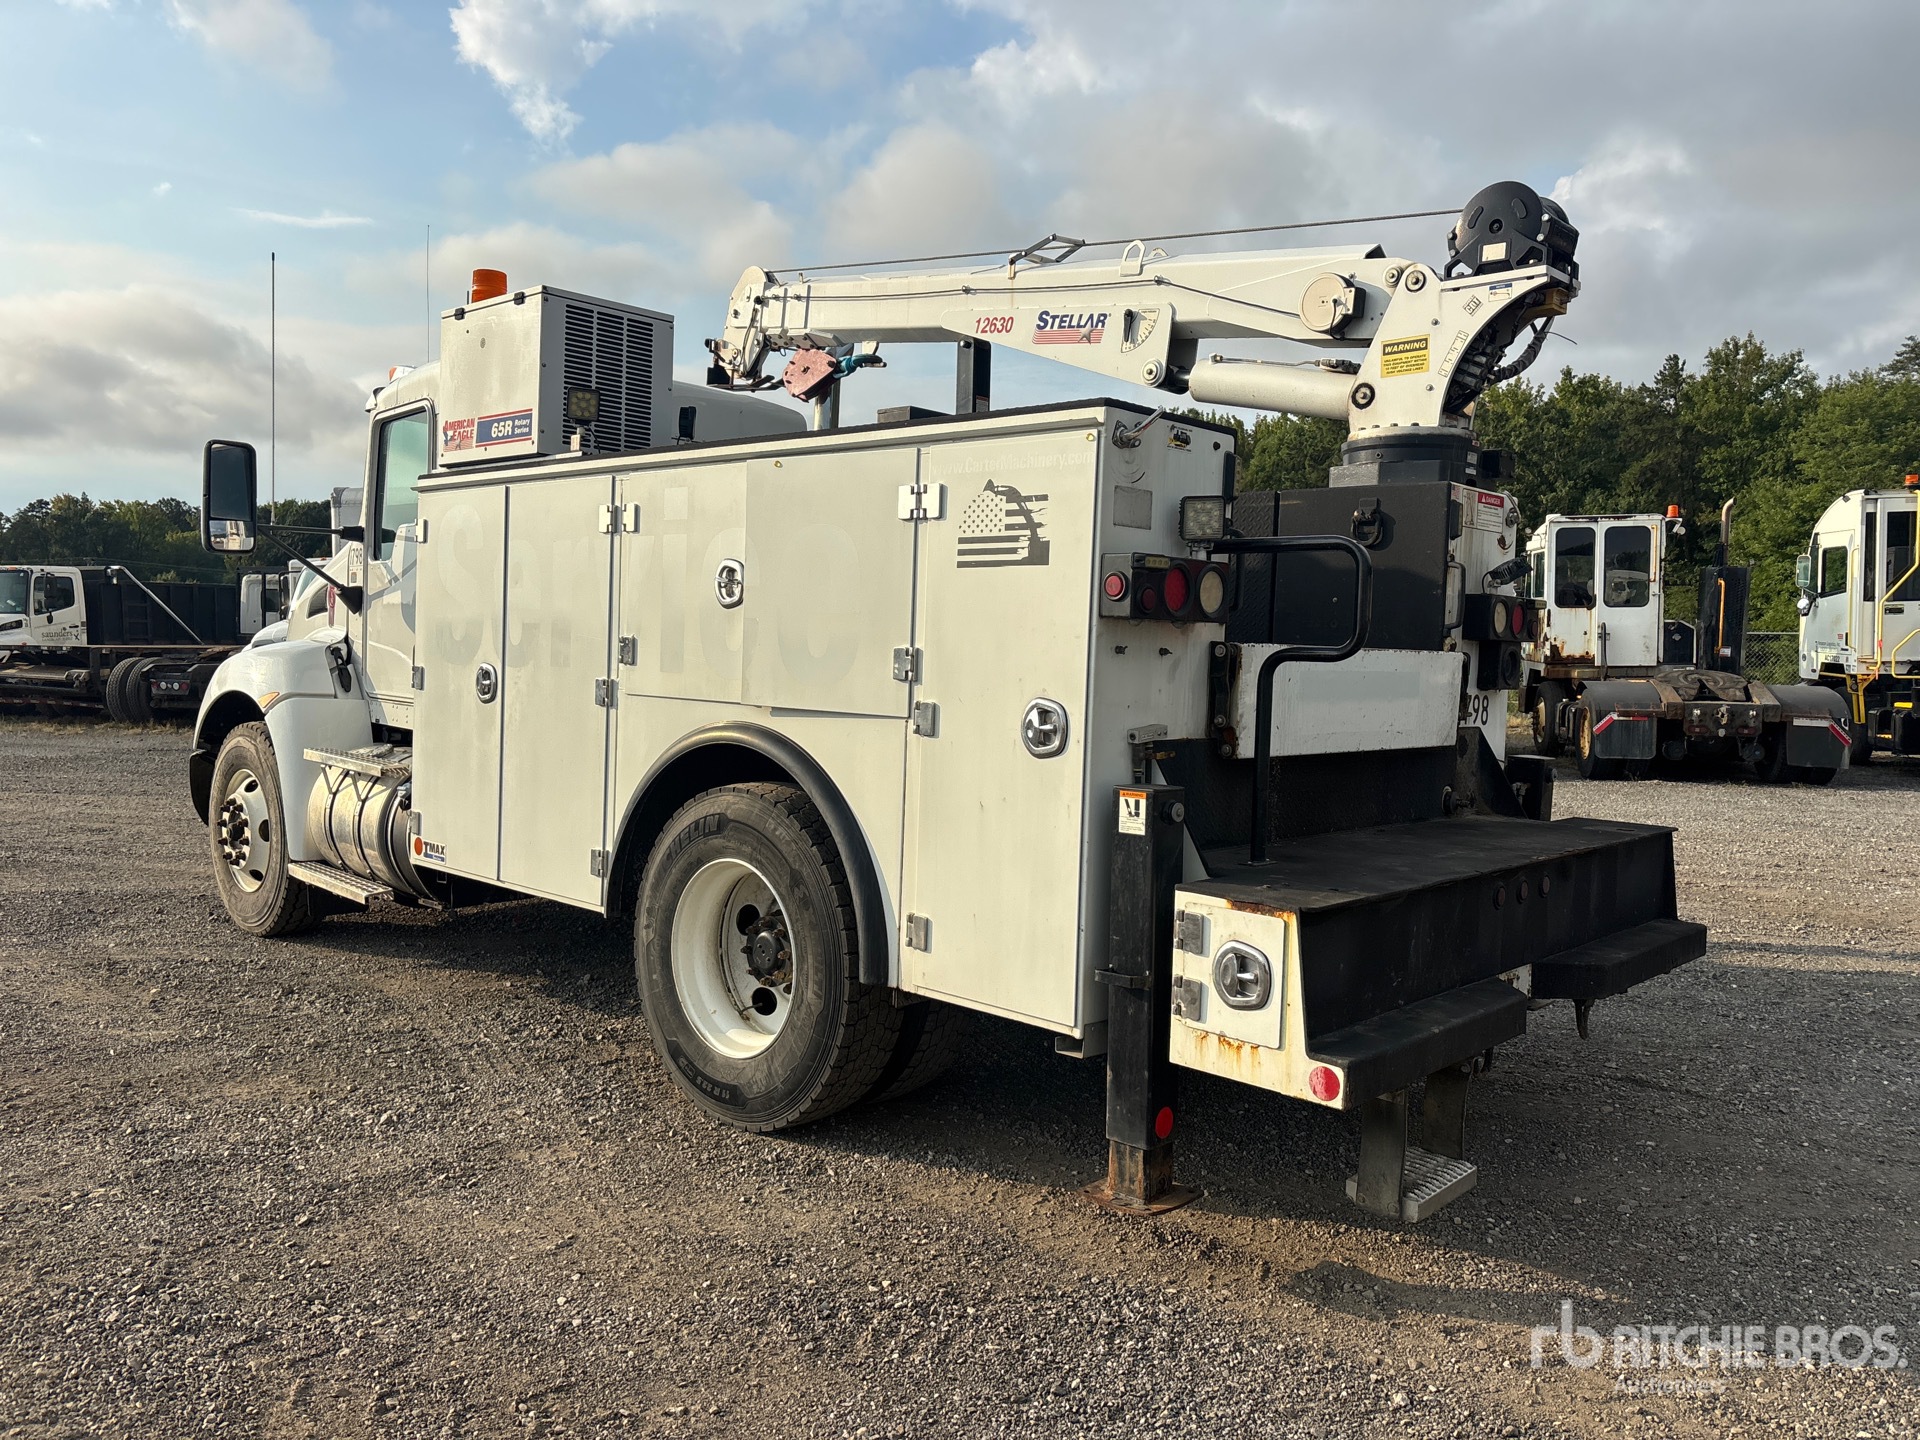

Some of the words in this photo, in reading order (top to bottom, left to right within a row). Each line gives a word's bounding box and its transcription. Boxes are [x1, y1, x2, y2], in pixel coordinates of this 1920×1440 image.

[975, 316, 1014, 334] 12630
[1035, 309, 1108, 330] STELLAR
[1384, 340, 1427, 354] WARNING
[443, 418, 476, 431] AMERICAN
[514, 418, 531, 427] Rotary
[452, 429, 474, 441] EAGLE
[491, 420, 513, 438] 65R
[514, 427, 529, 435] Series
[1485, 497, 1501, 505] DANGER
[41, 628, 73, 638] saunders
